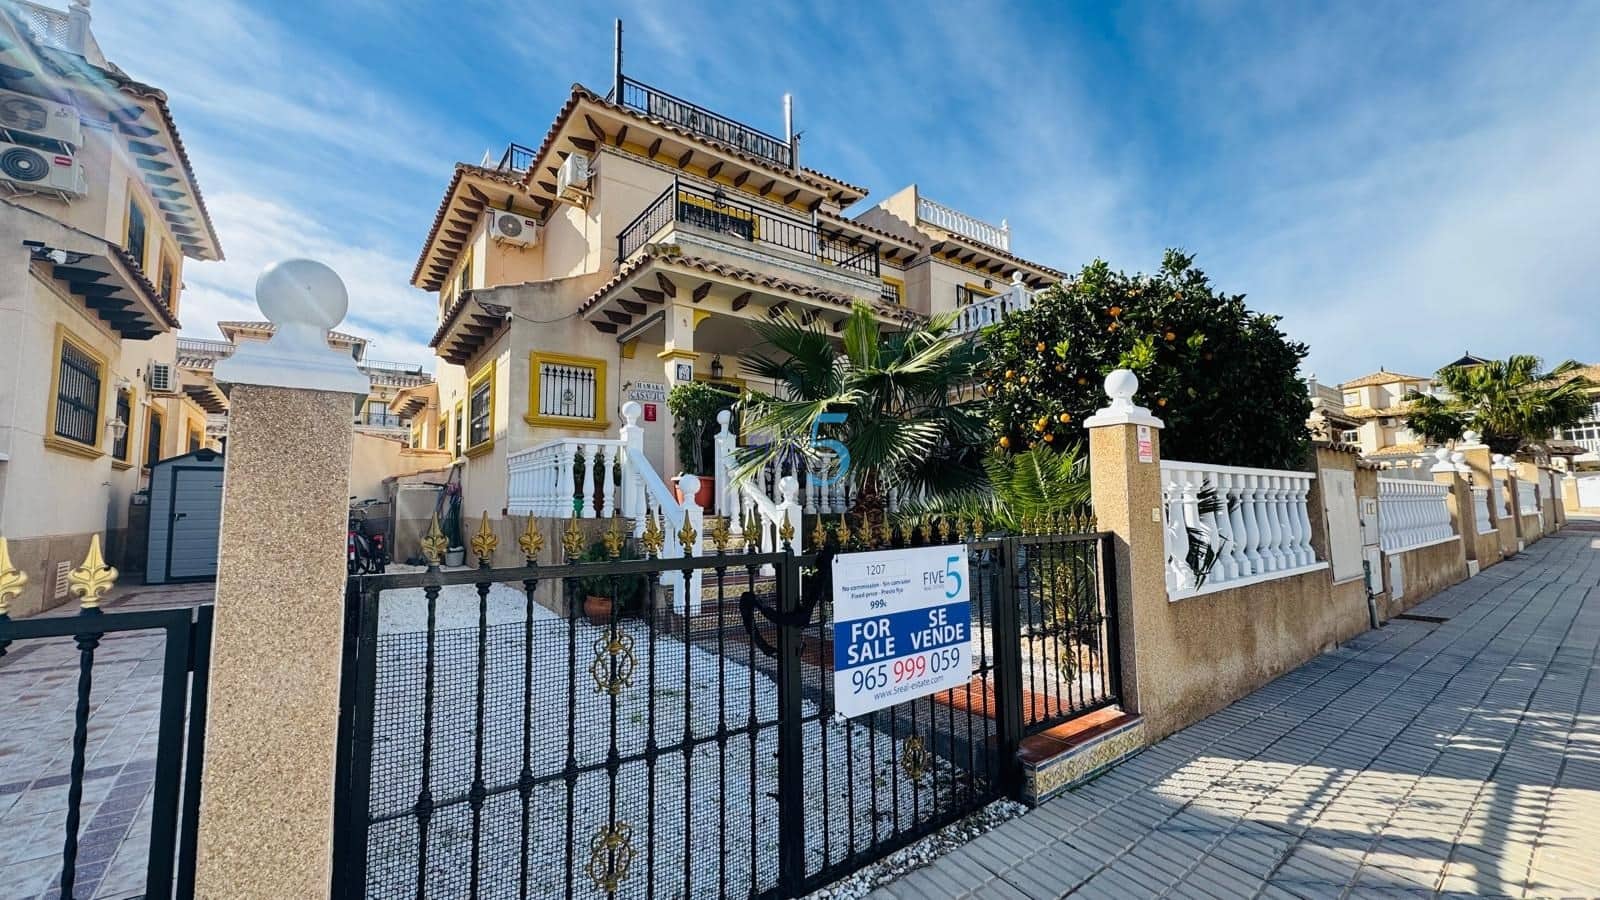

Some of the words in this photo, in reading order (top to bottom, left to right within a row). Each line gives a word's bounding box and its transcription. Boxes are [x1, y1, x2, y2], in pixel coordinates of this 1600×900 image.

[866, 564, 886, 576] 1207
[923, 570, 945, 585] FIVE
[945, 556, 962, 599] 5
[851, 618, 891, 643] FOR
[928, 608, 948, 628] SE
[910, 623, 965, 650] VENDE
[847, 637, 896, 665] SALE
[852, 664, 888, 695] 965
[893, 655, 926, 683] 999
[931, 647, 960, 673] 059
